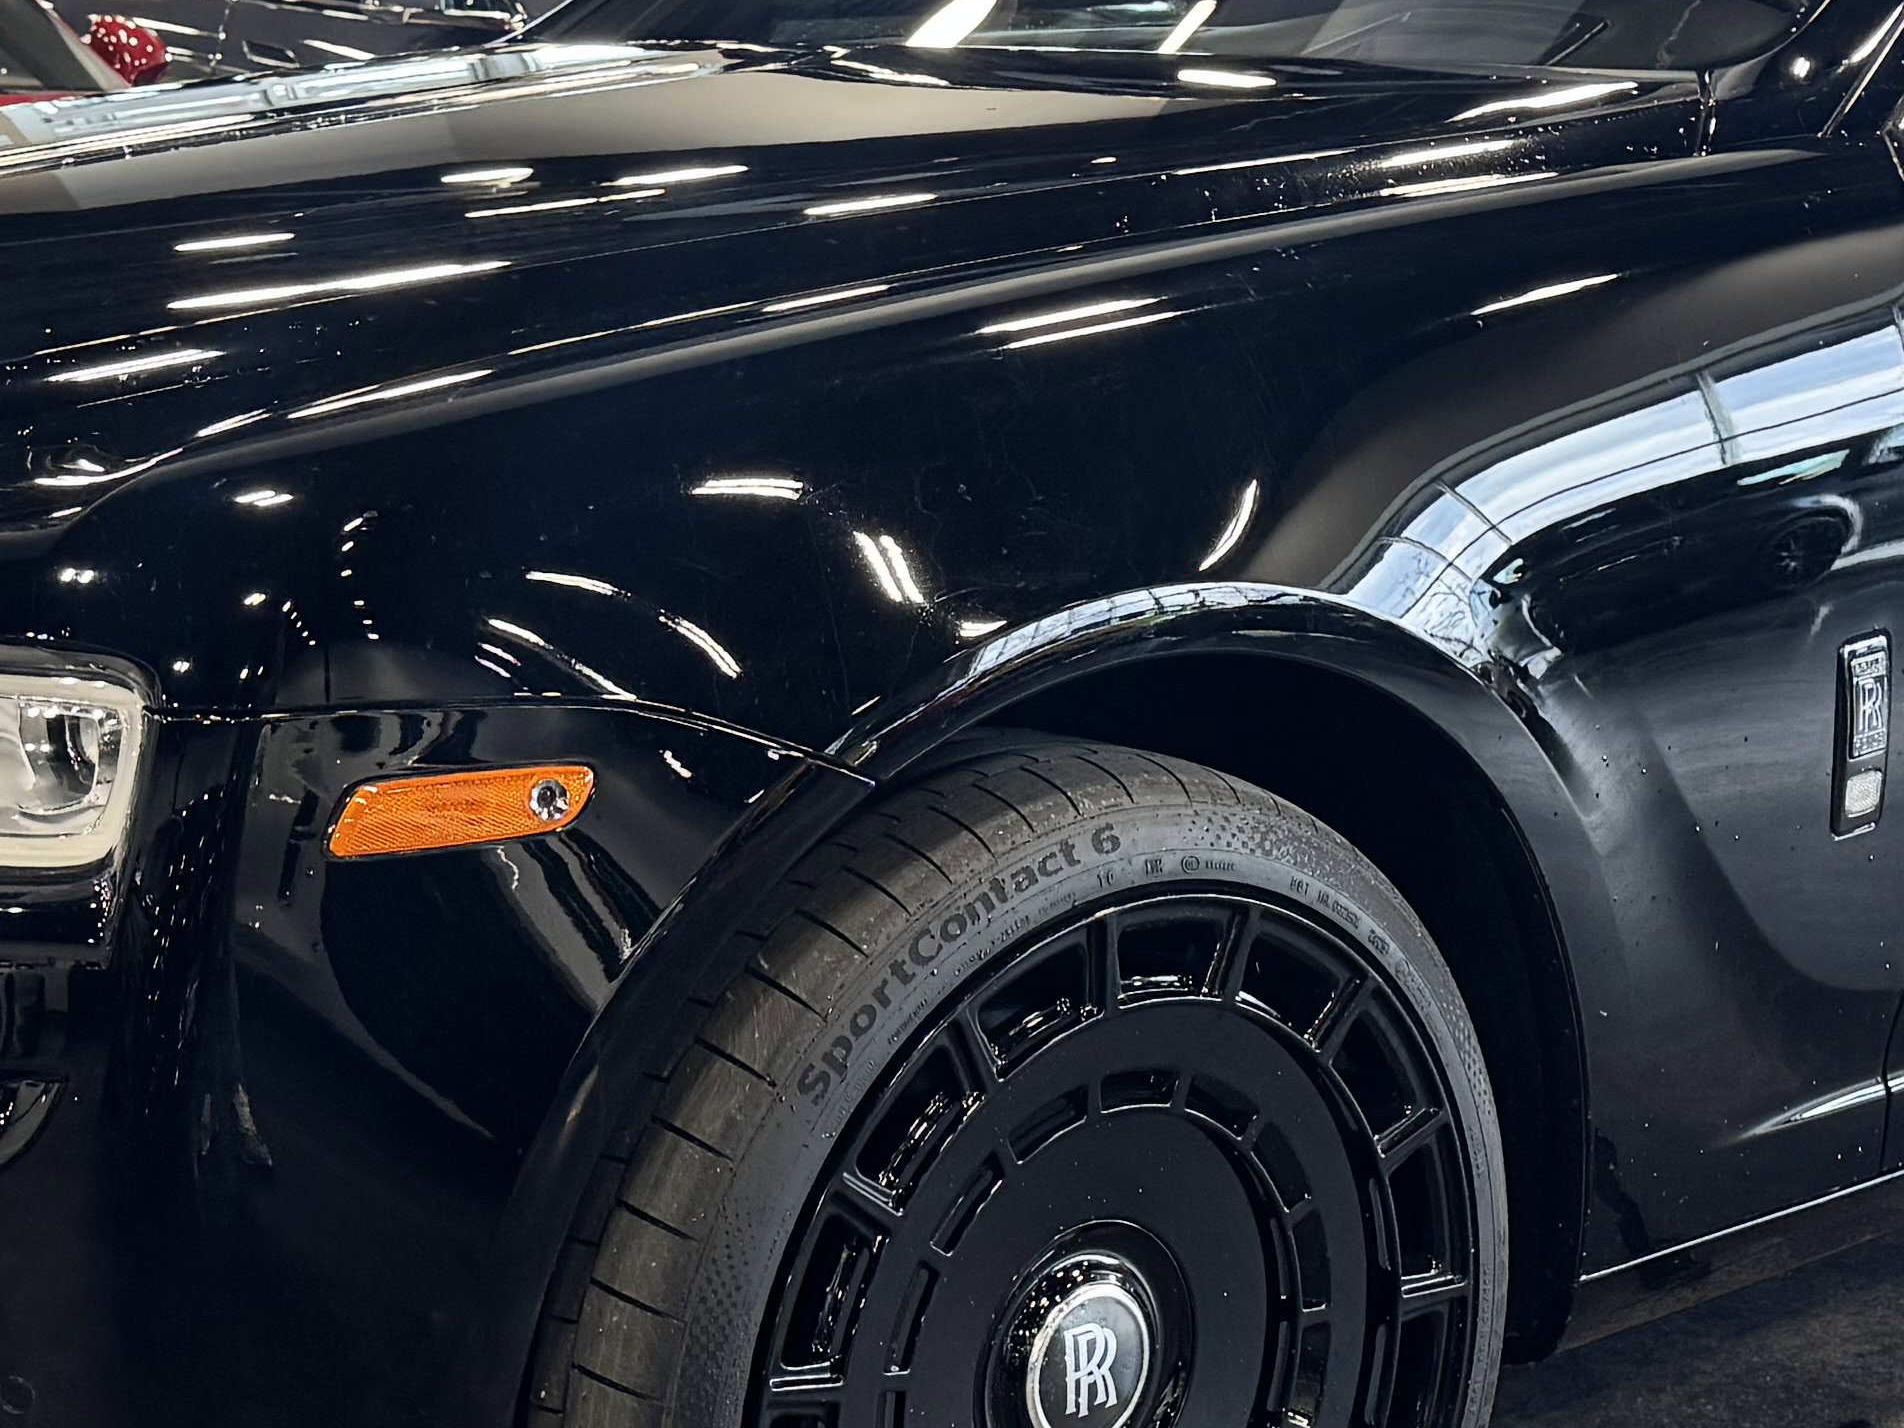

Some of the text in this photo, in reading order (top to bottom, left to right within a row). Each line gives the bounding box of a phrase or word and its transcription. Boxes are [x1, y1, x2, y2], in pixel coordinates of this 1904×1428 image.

[797, 822, 1122, 1106] SportContact 6
[1063, 1322, 1118, 1419] RR
